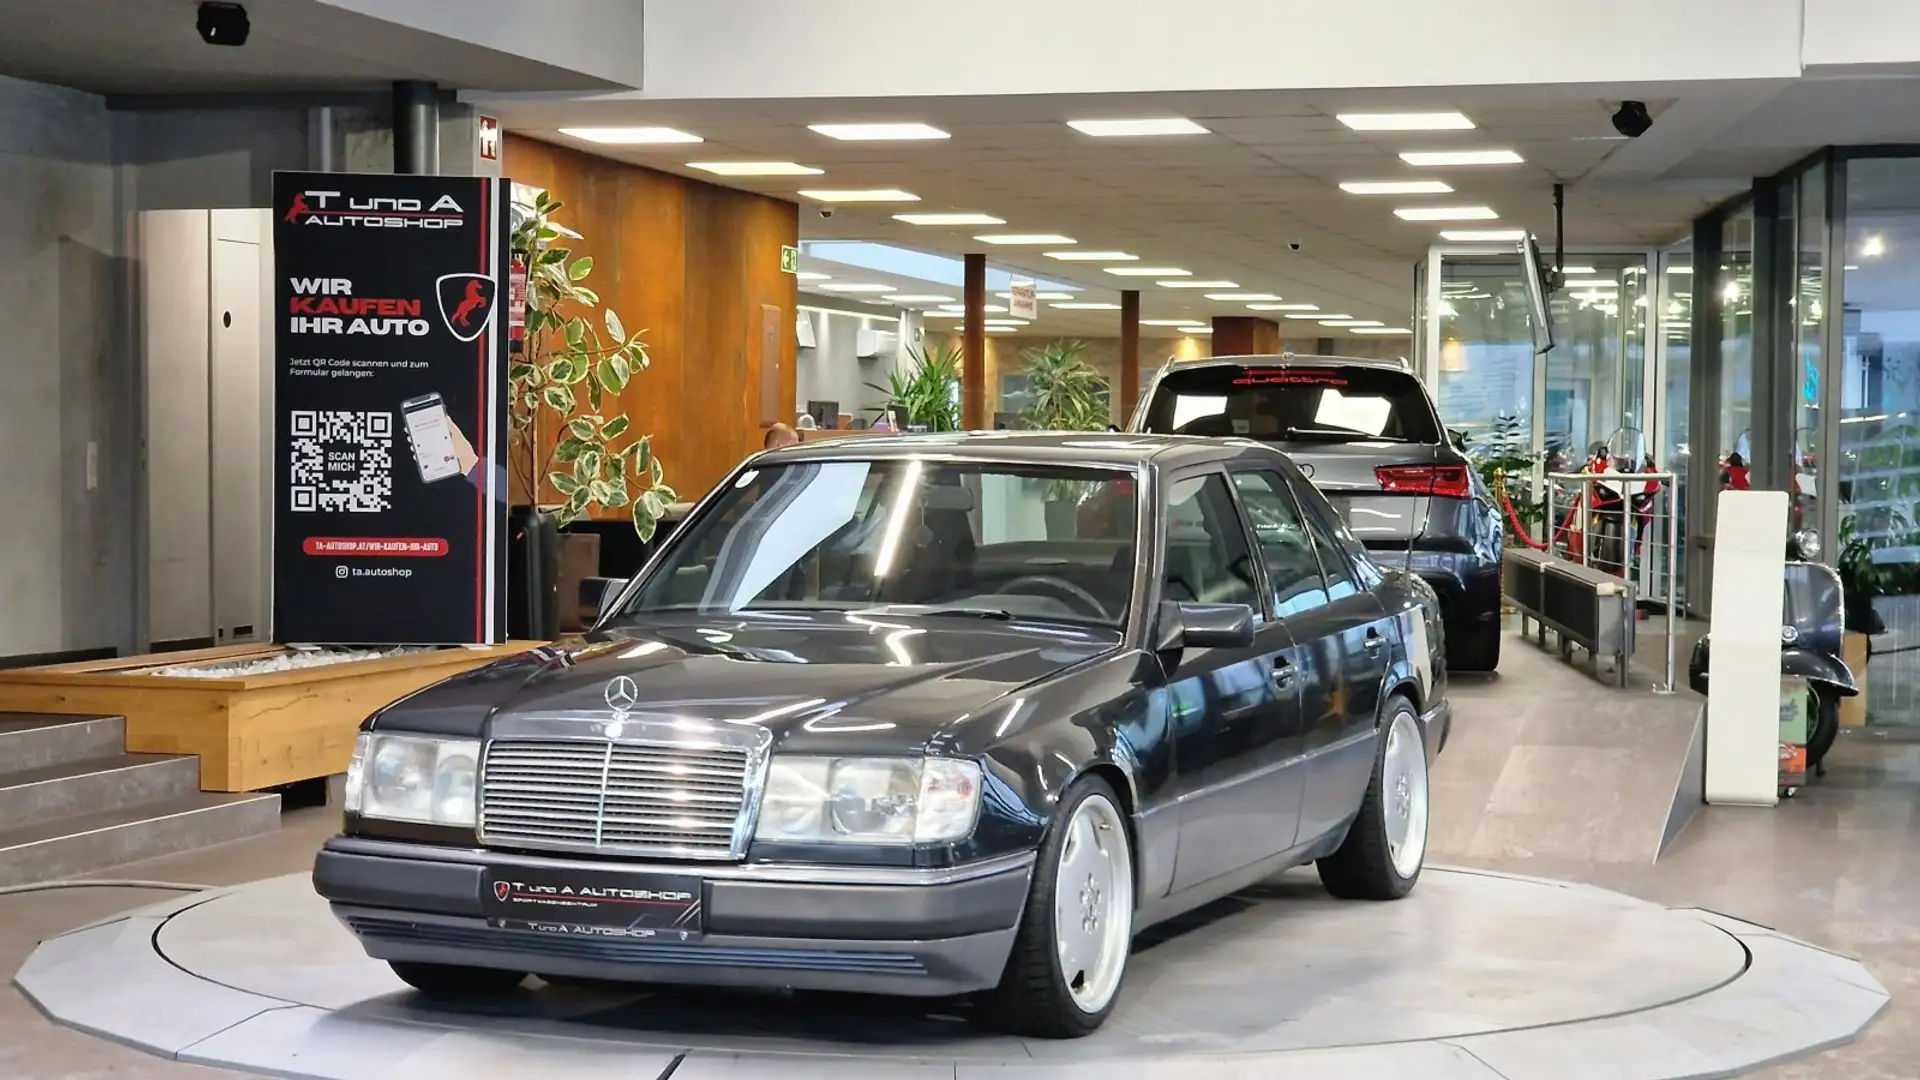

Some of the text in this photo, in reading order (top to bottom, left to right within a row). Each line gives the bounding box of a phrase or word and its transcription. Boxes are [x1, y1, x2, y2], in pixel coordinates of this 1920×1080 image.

[305, 191, 340, 209] T
[428, 195, 464, 212] A
[305, 216, 463, 229] AUTOSHOP
[290, 278, 352, 295] WIR
[290, 297, 421, 316] KAUFEN
[290, 317, 430, 336] IHR AUTO
[289, 358, 429, 369] Jetzt QR Code scannen und zum
[290, 369, 374, 379] Formular gelangen:
[1232, 376, 1348, 384] quattro
[328, 452, 355, 461] SCAN
[328, 462, 355, 471] MICH
[352, 567, 412, 578] ta.autoshop
[512, 882, 524, 891] T
[561, 886, 574, 895] A
[580, 886, 692, 900] AUTOSHOP
[528, 922, 538, 931] T
[558, 925, 569, 933] A
[573, 926, 656, 938] AUTOSHOP
